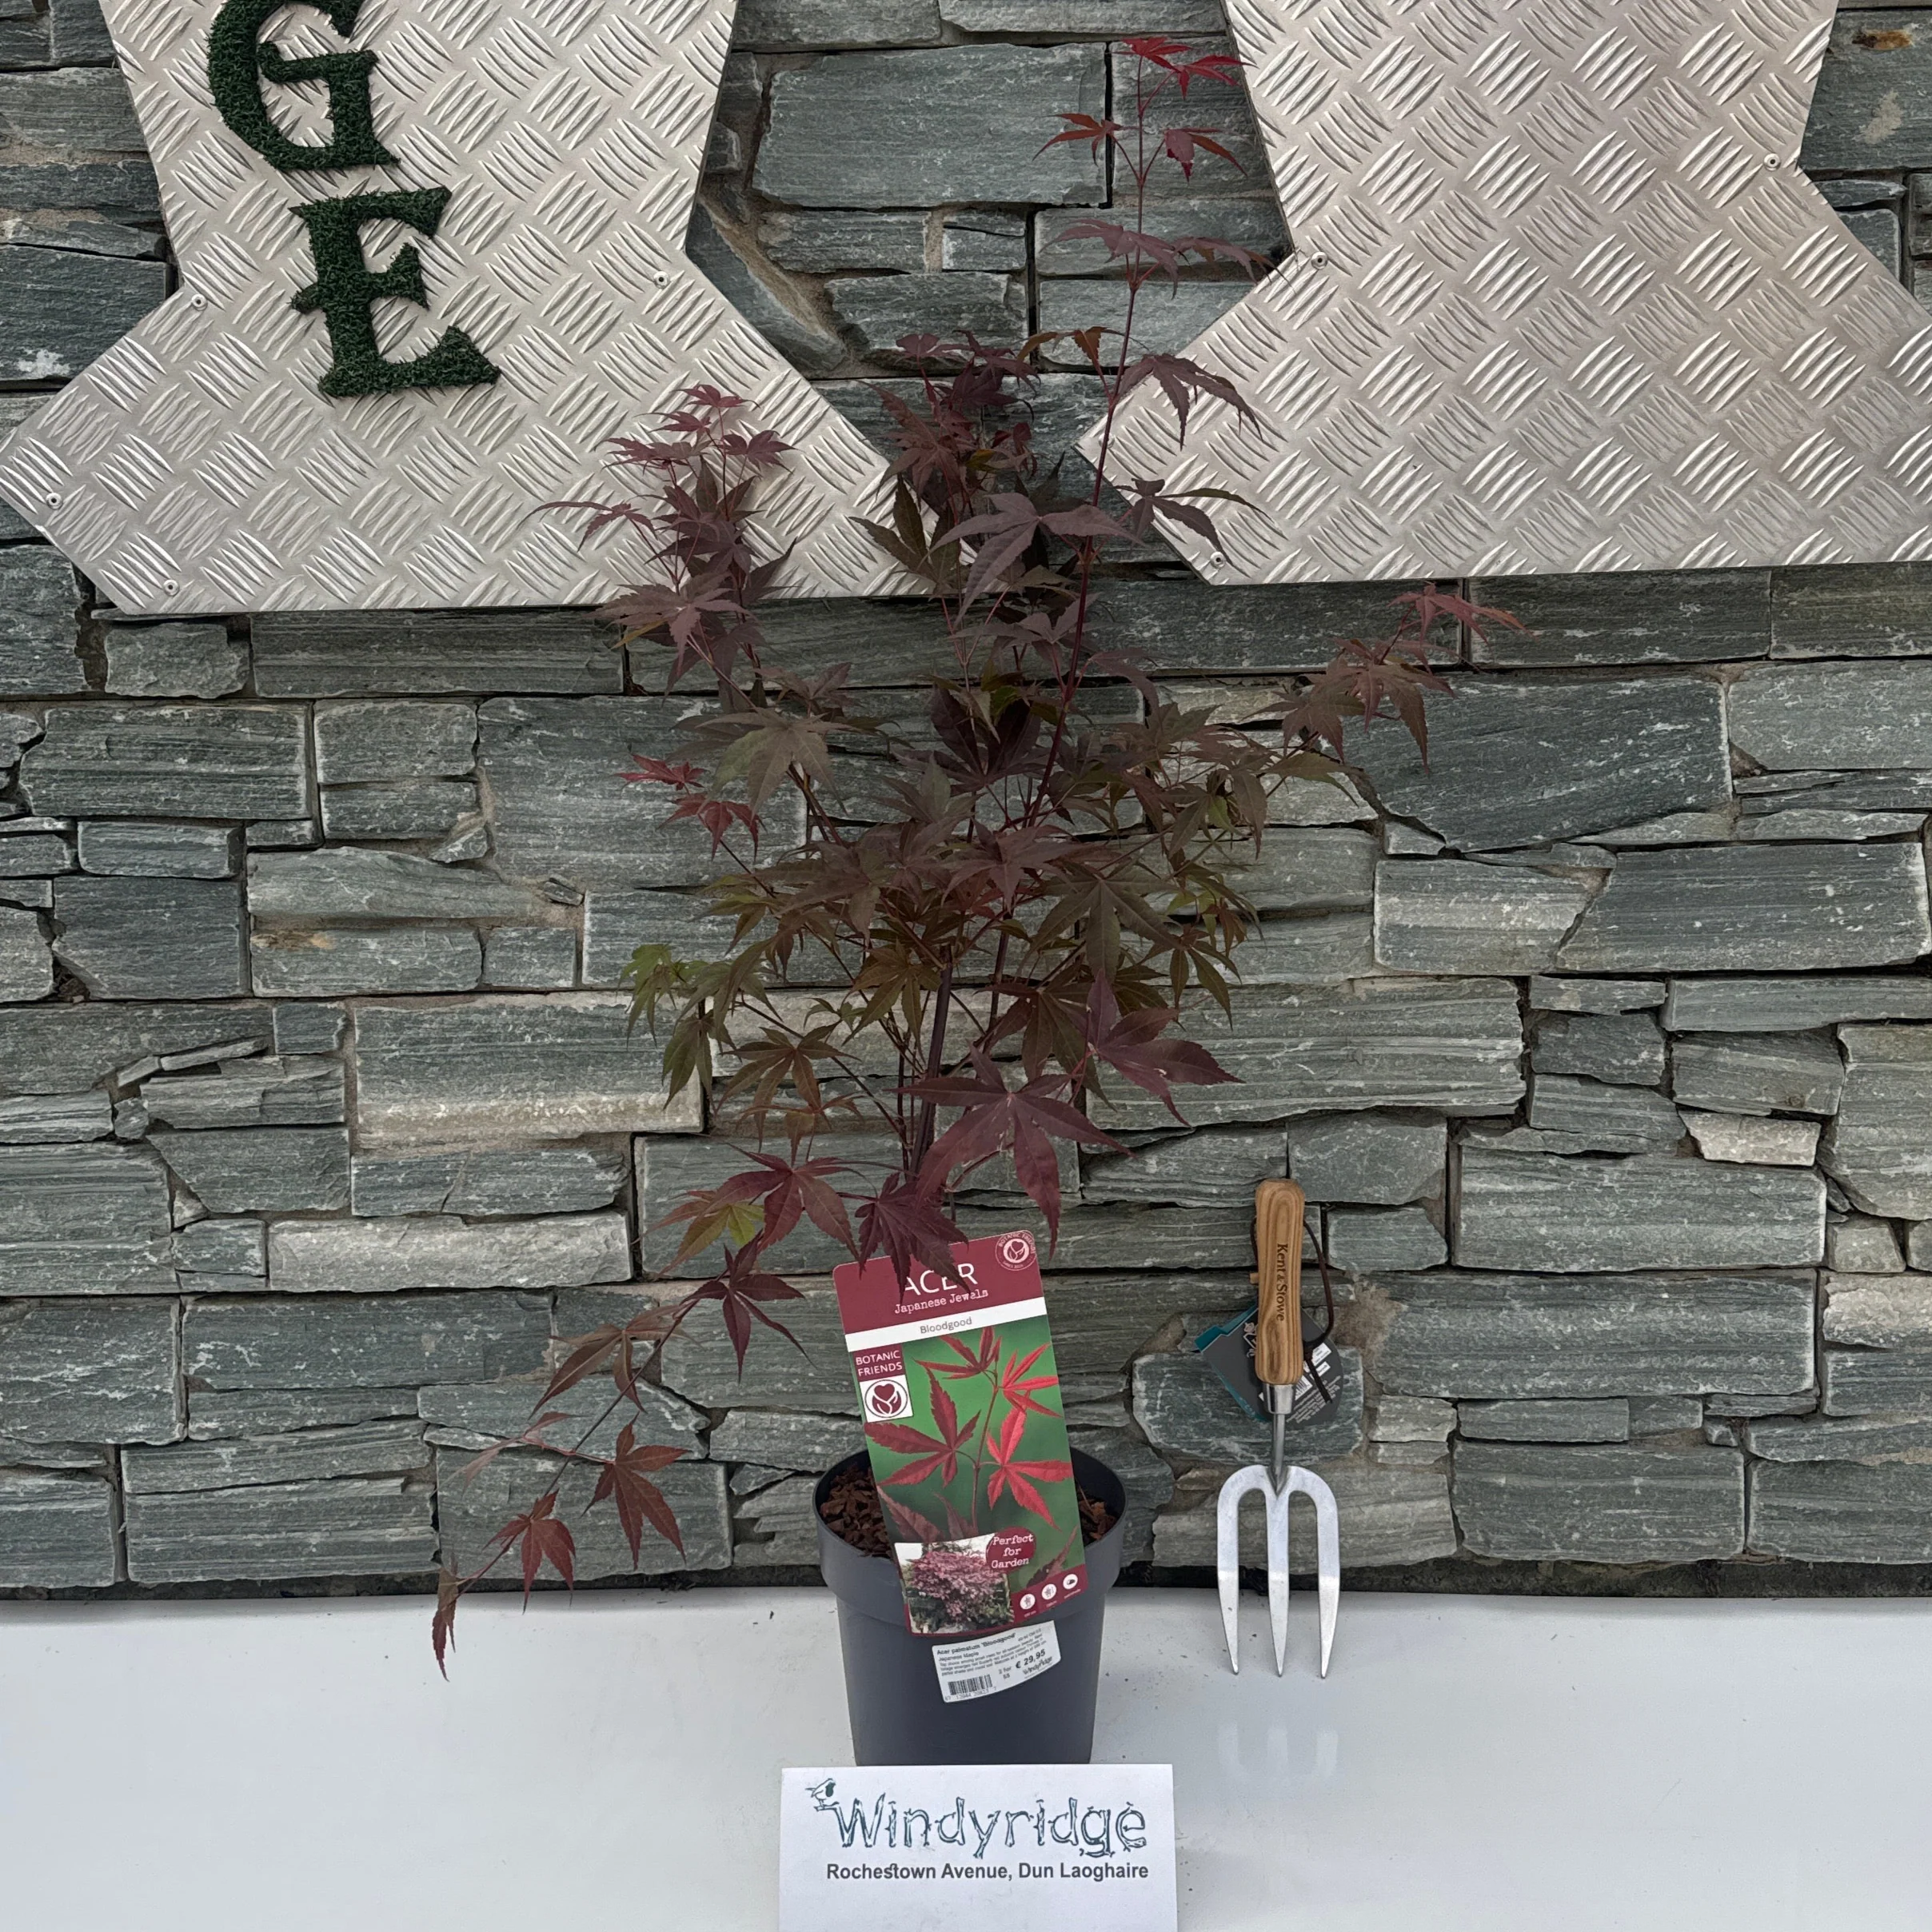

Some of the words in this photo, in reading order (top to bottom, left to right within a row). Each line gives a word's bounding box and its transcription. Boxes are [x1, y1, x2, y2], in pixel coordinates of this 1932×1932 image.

[1277, 1243, 1288, 1272] Kent
[894, 1296, 947, 1314] Japanese
[949, 1288, 988, 1305] Jewels
[1276, 1283, 1288, 1322] Stowe
[920, 1317, 972, 1334] Bloodgood
[856, 1350, 900, 1366] BOTANIC
[857, 1361, 903, 1377] FRIENDS
[992, 1534, 1034, 1547] Perfect
[1003, 1547, 1021, 1557] for
[991, 1556, 1030, 1569] Garden
[825, 1792, 1147, 1859] Windyridge
[826, 1863, 936, 1880] Rochestown
[941, 1863, 1012, 1882] Avenue,
[1019, 1862, 1053, 1879] Dun
[1060, 1862, 1148, 1882] Laoghaire
